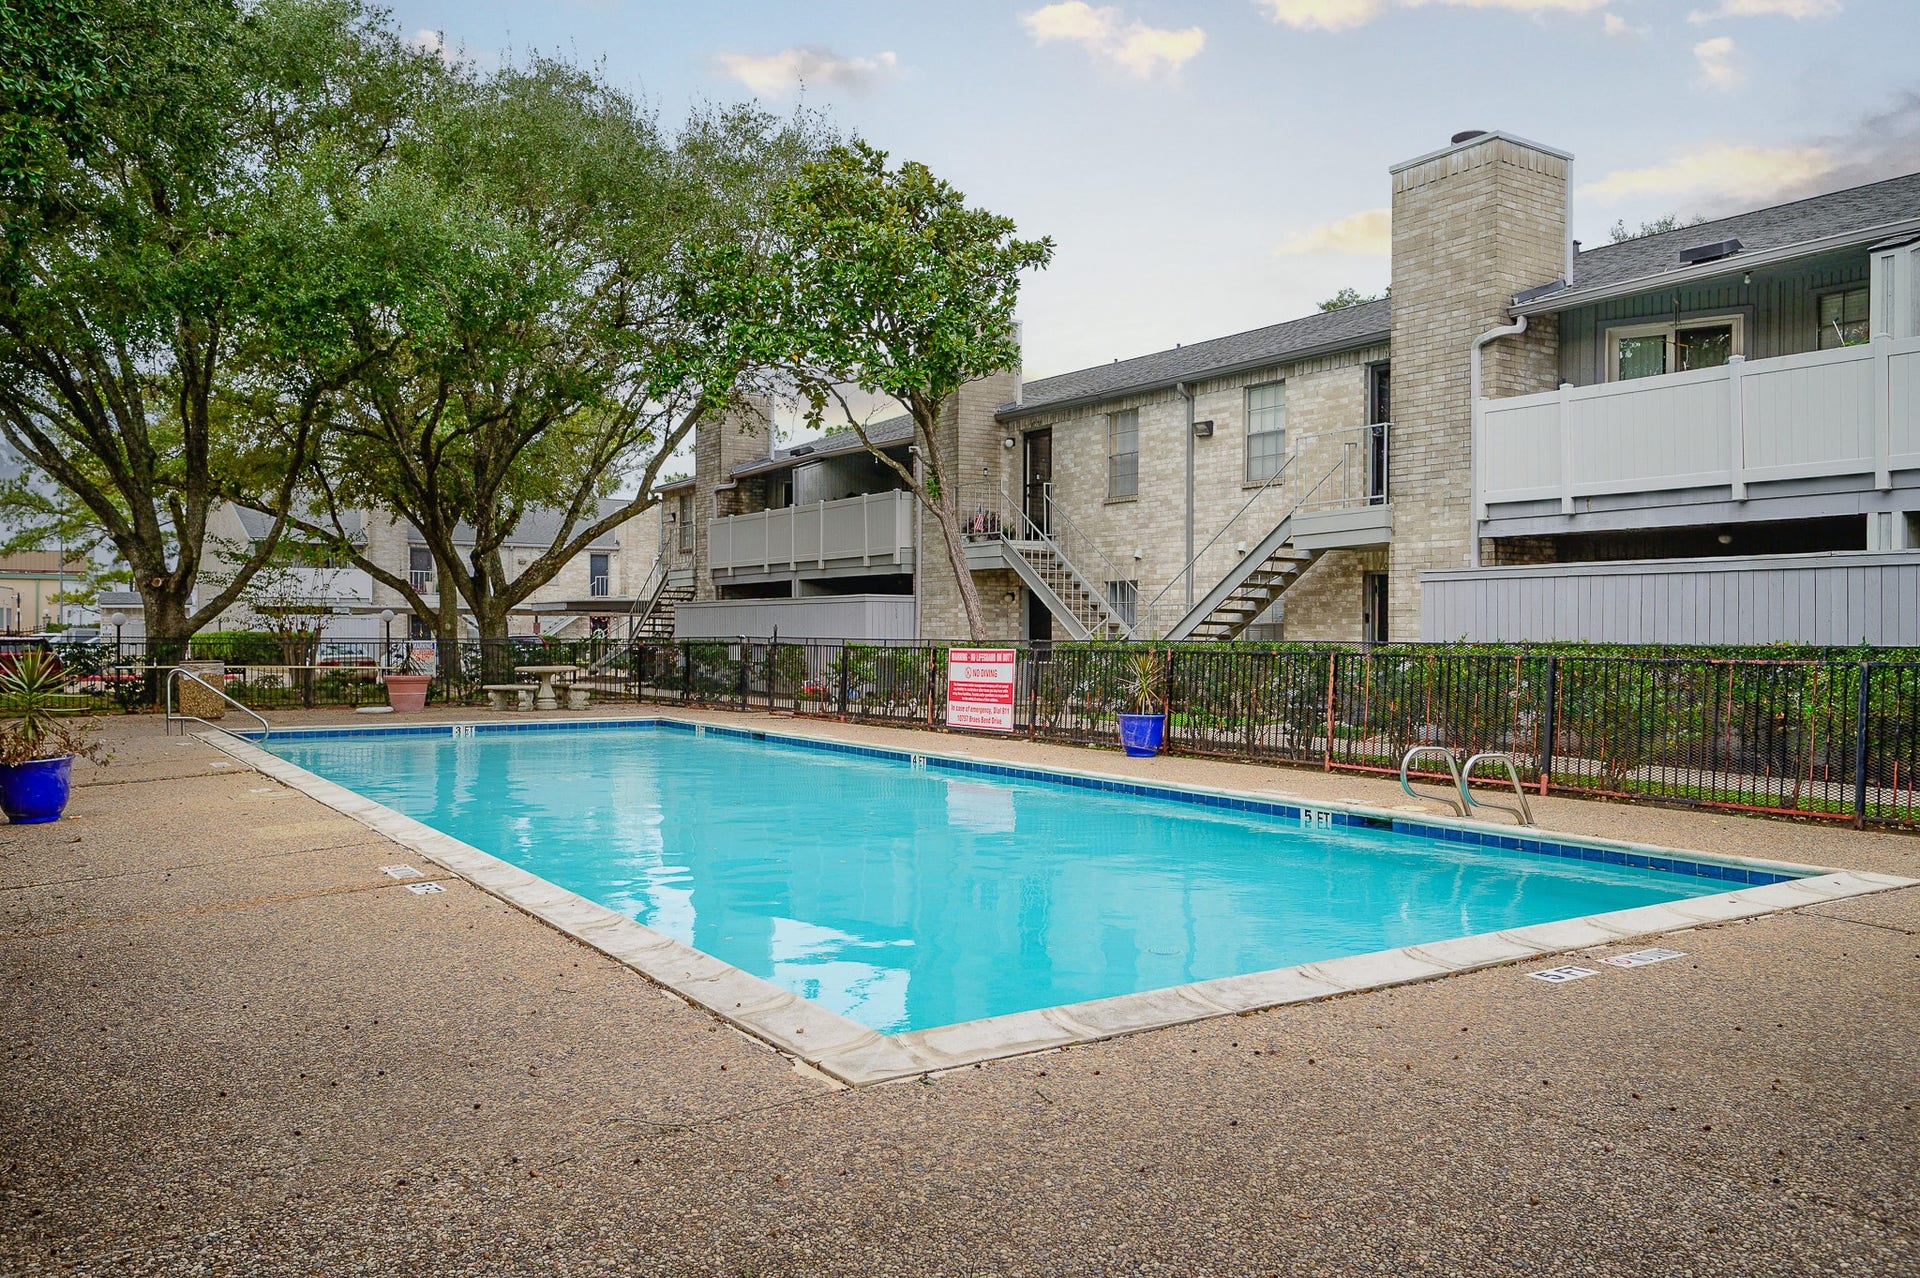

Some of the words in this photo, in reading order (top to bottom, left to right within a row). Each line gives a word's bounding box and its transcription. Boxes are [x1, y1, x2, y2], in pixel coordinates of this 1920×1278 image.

[976, 653, 996, 662] LIFEGUARD
[973, 669, 980, 677] NO
[981, 669, 998, 678] DIVING
[991, 717, 1002, 725] Drive
[455, 726, 461, 734] 3
[464, 725, 474, 734] FT
[912, 755, 917, 764] 4
[1304, 809, 1312, 821] 5
[1317, 811, 1330, 823] FT
[1535, 972, 1566, 980] 5
[1553, 966, 1592, 977] FT
